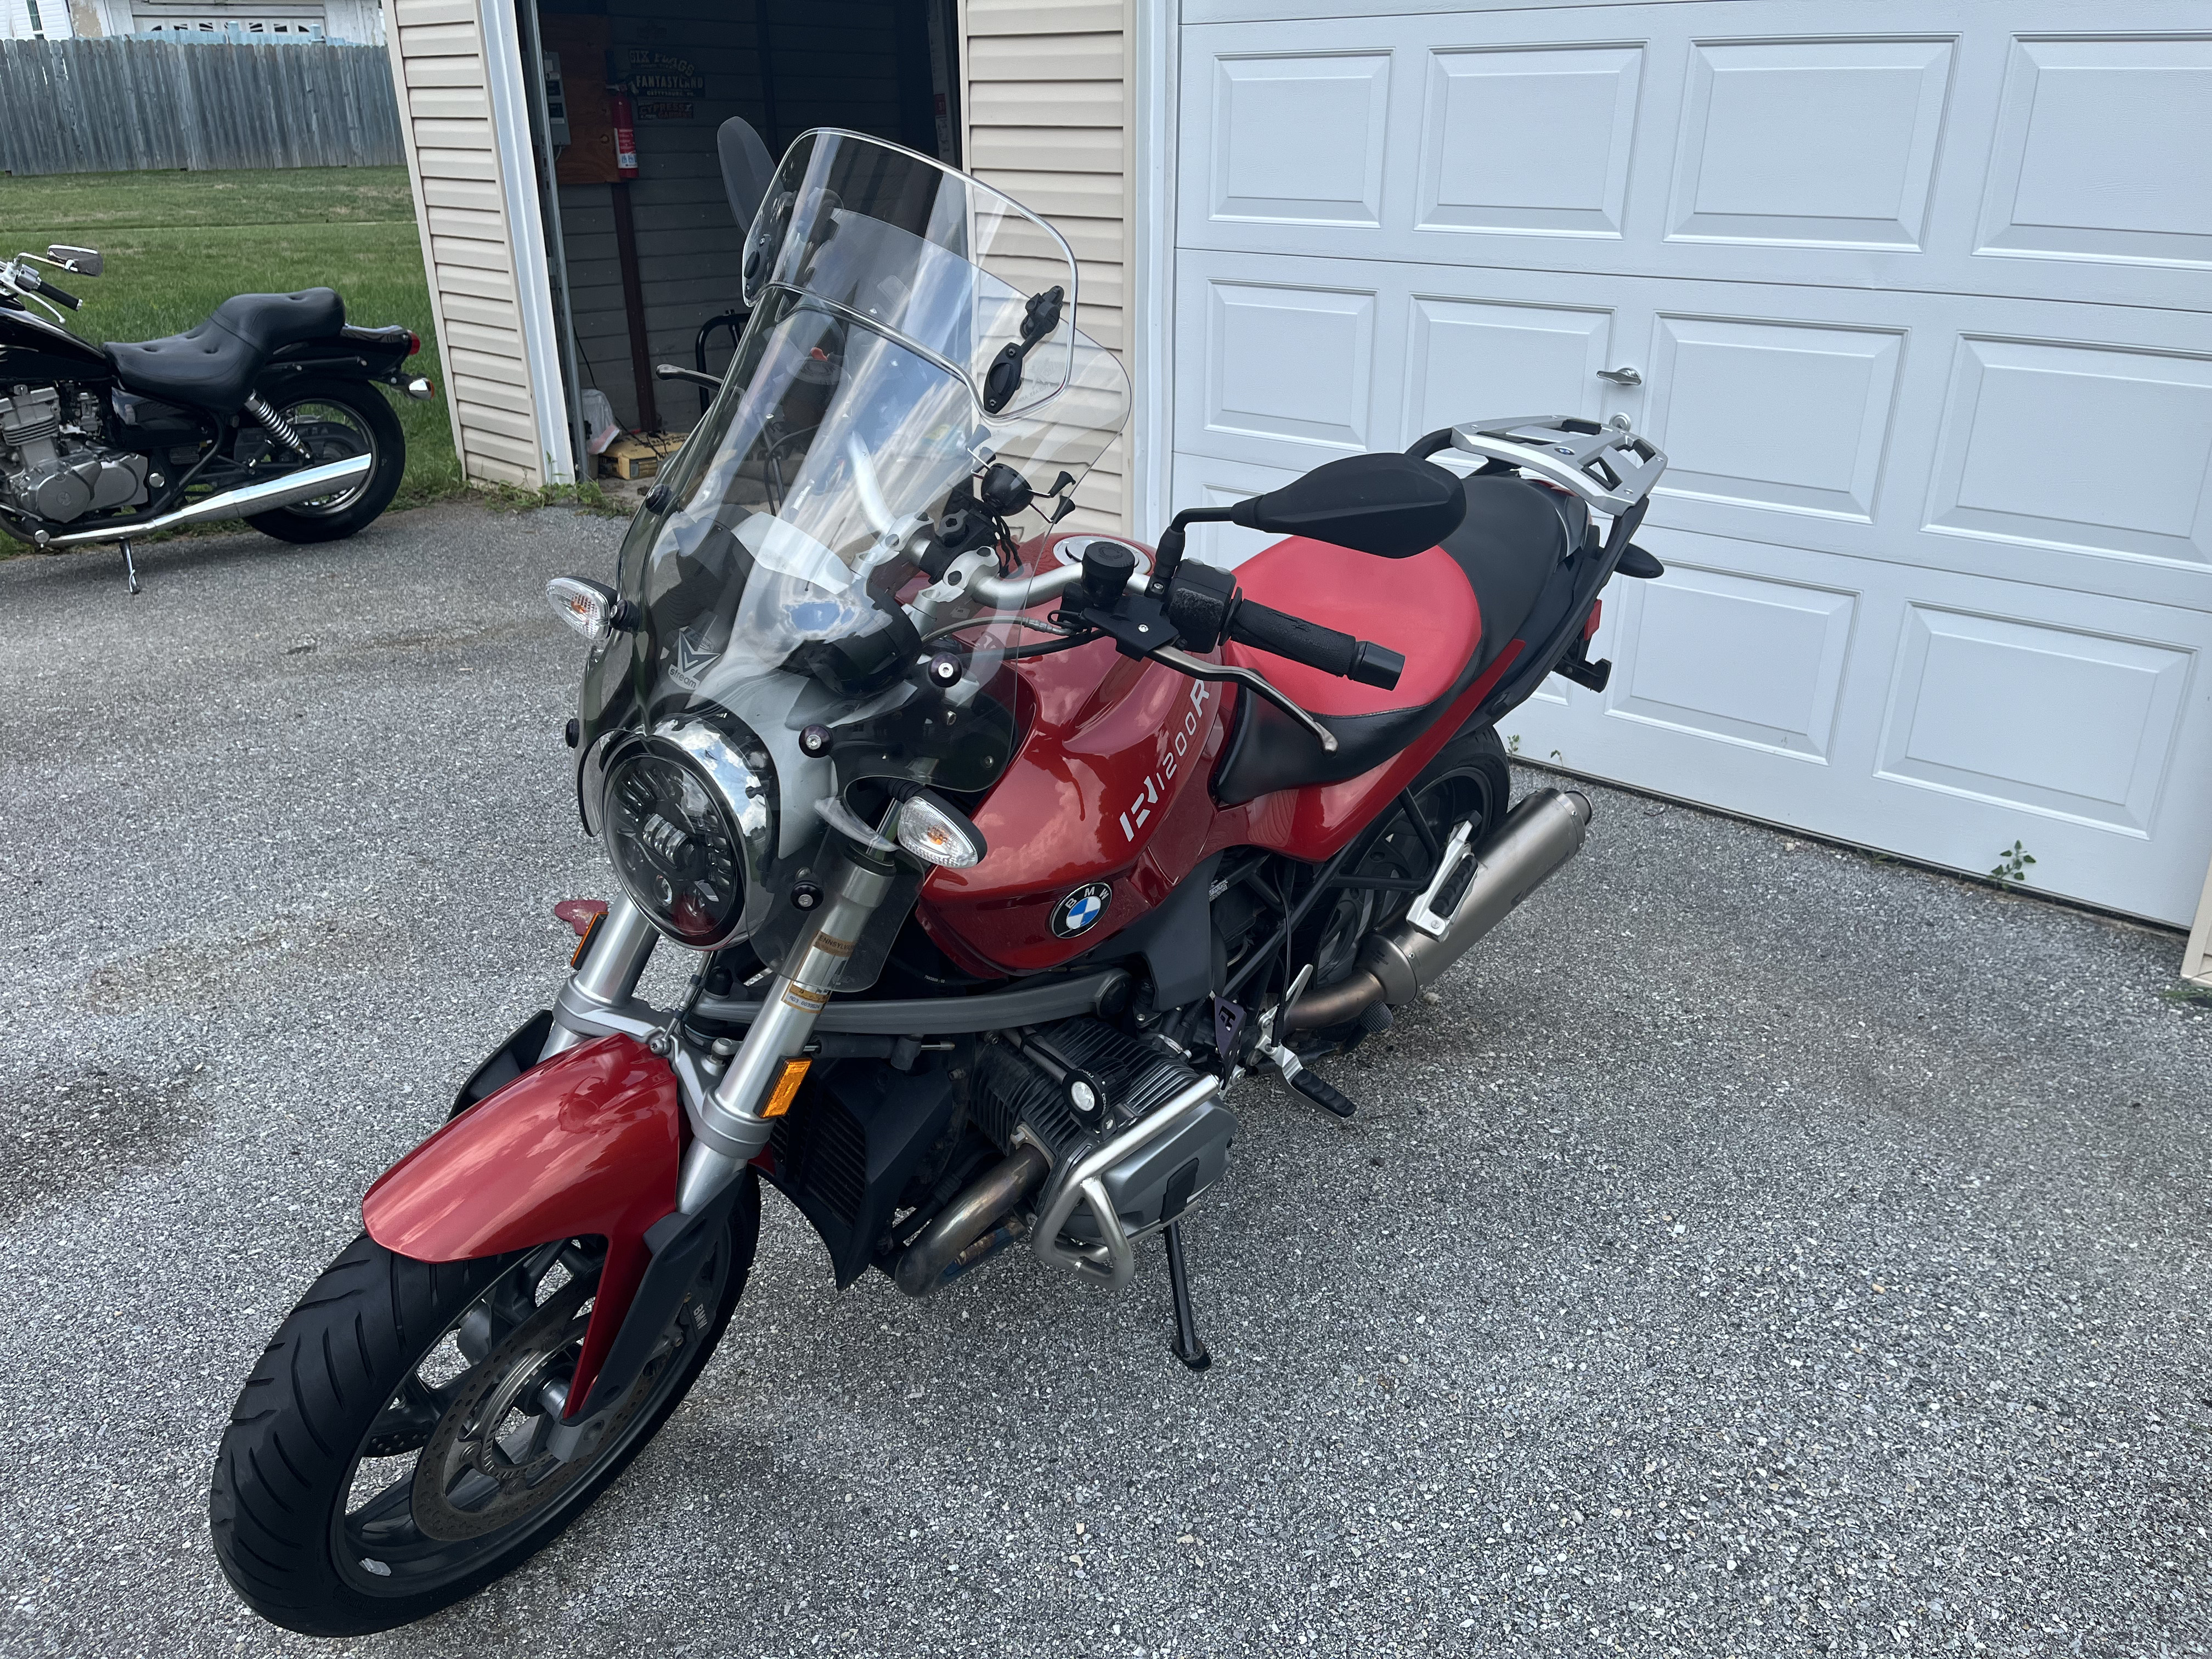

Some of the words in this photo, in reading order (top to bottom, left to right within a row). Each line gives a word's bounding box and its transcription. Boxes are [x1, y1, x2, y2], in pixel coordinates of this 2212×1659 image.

[629, 50, 650, 63] SIX
[654, 53, 695, 77] FLAGS
[640, 103, 684, 115] CYPRESS
[669, 668, 697, 689] stream
[1065, 886, 1109, 909] BMW
[693, 1303, 708, 1330] BMW
